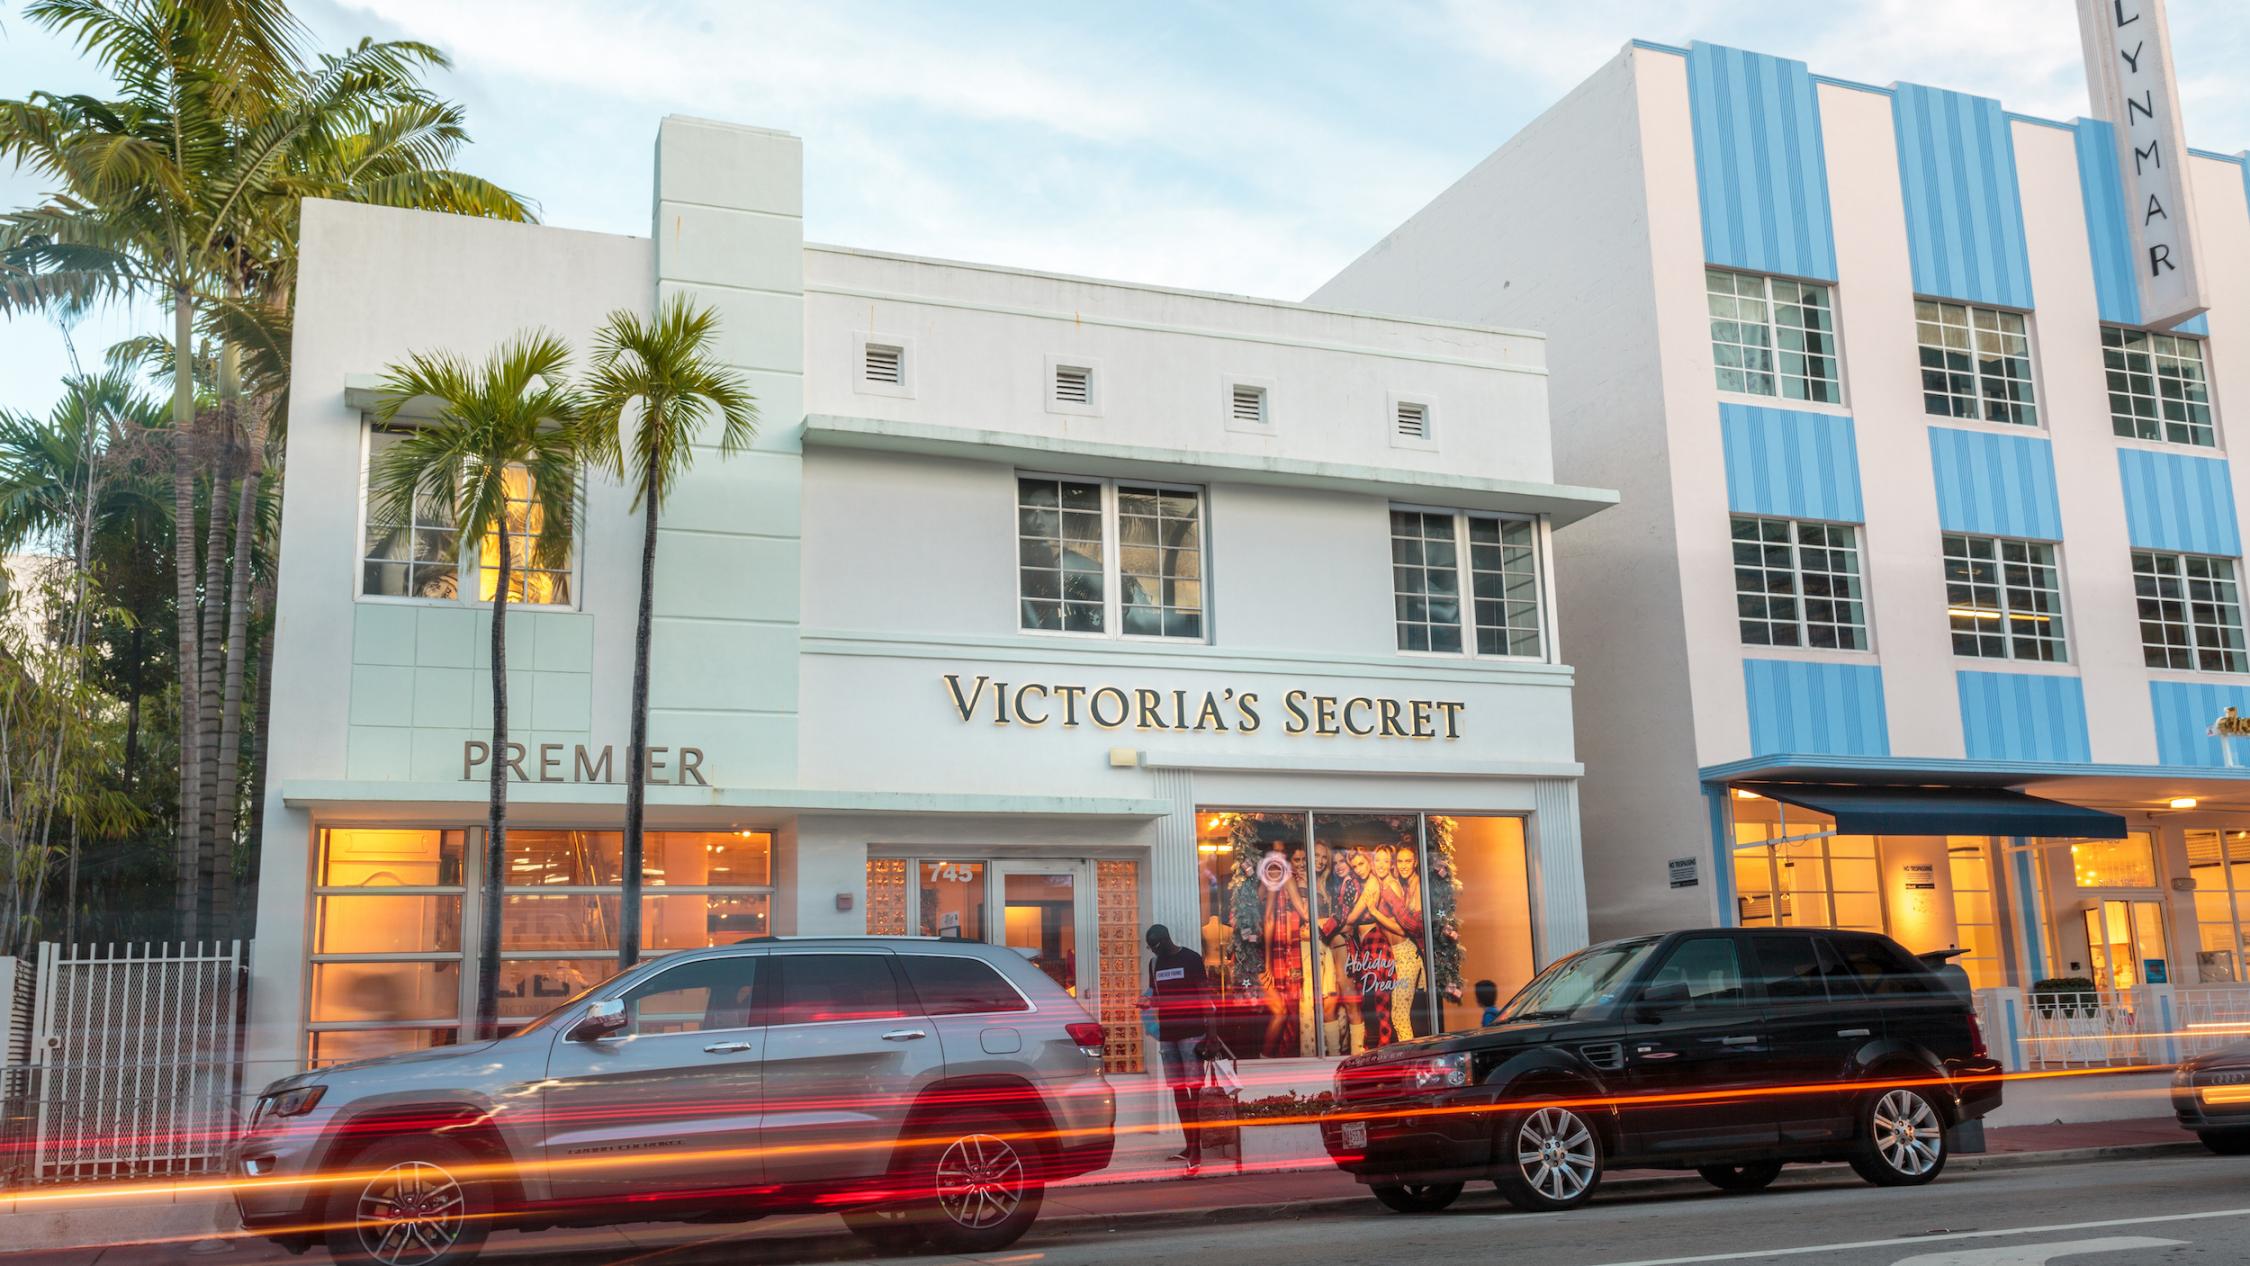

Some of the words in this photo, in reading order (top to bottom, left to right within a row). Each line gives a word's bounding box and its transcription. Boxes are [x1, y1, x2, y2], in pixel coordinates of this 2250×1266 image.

[2114, 0, 2176, 277] LYNMAR
[943, 674, 1261, 732] VICTORIA'S
[1285, 689, 1465, 739] SECRET
[464, 740, 708, 785] PREMIER
[928, 863, 974, 883] 745
[1344, 949, 1396, 977] Holiday
[1360, 971, 1409, 996] Dreams
